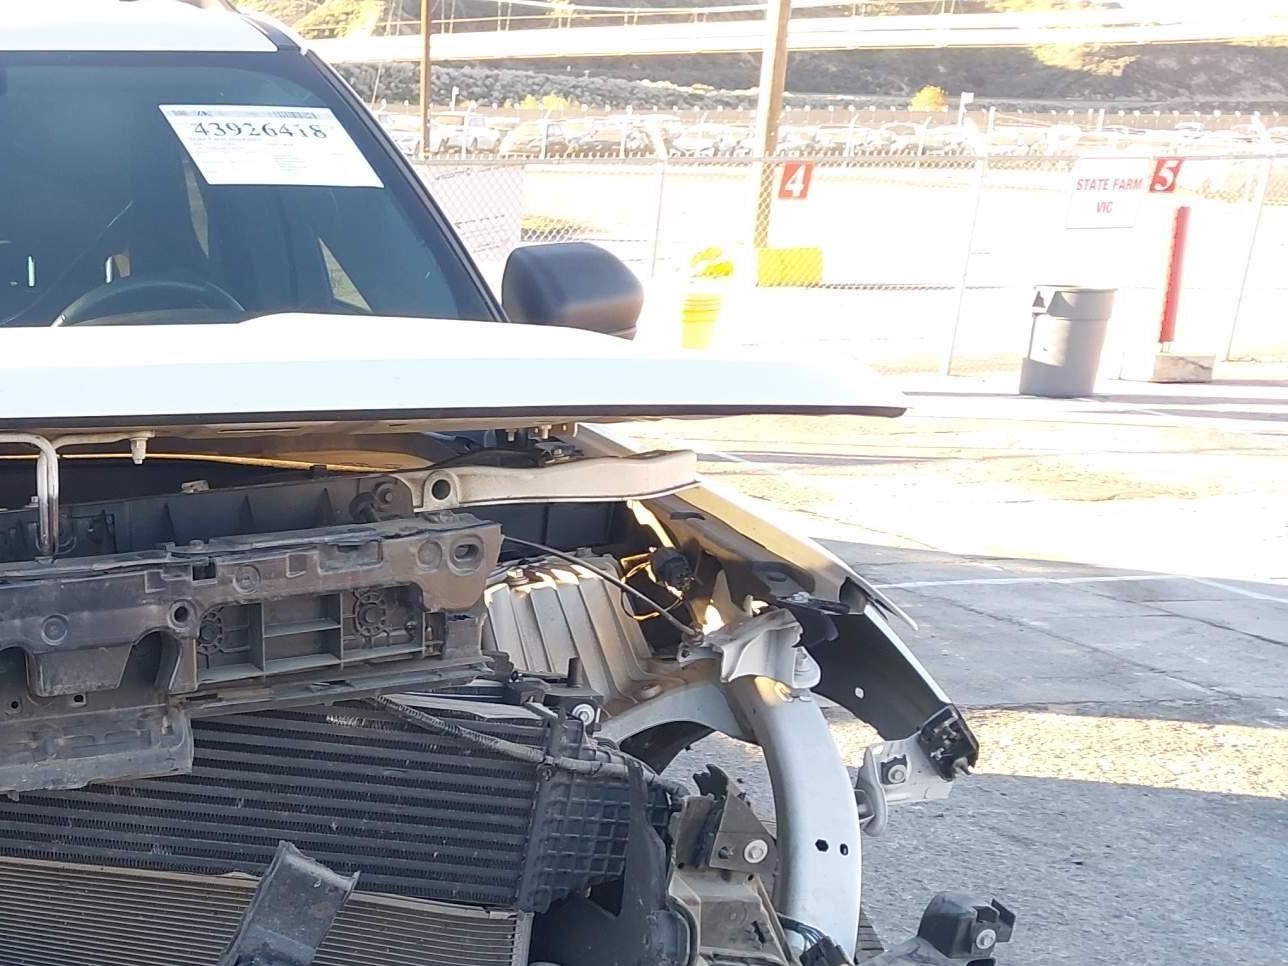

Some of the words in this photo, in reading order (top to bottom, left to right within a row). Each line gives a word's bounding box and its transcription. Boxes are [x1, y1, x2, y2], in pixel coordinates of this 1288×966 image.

[194, 122, 328, 139] 43926418
[784, 163, 807, 198] 4
[1153, 160, 1182, 191] 5
[1076, 178, 1110, 191] STATE
[1112, 178, 1143, 190] FARM
[1096, 201, 1113, 213] VIC
